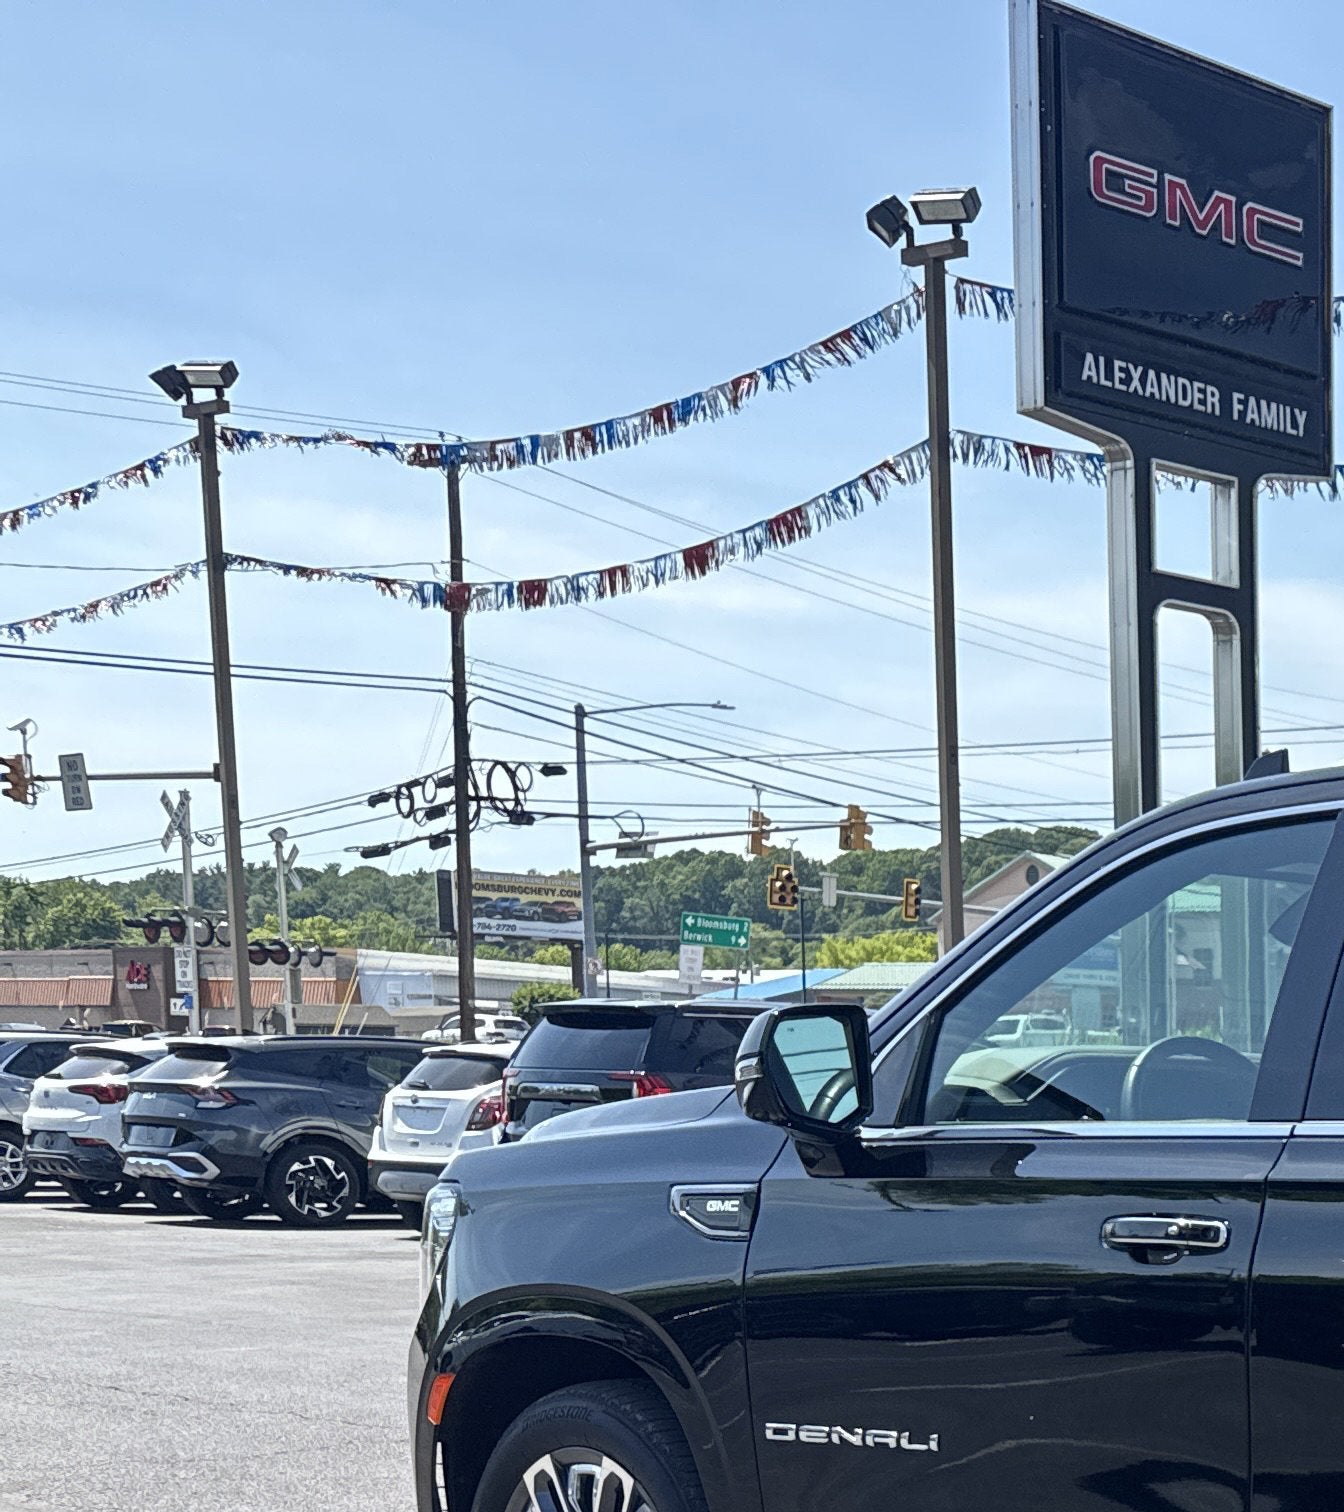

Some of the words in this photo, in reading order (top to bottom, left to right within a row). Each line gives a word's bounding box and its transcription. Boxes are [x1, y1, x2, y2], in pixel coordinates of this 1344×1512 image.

[1089, 150, 1303, 267] GMC
[1081, 352, 1221, 417] ALEXANDER
[1232, 392, 1308, 438] FAMILY
[66, 760, 79, 771] NO
[473, 882, 582, 898] OMSBURGCHEVY.COM
[473, 921, 517, 932] -784-2720
[697, 917, 740, 932] Bloomsburg
[743, 921, 749, 932] 2
[683, 930, 713, 943] Berwick
[731, 935, 736, 945] 9
[706, 1199, 740, 1212] GMC
[765, 1422, 939, 1451] DENALI
